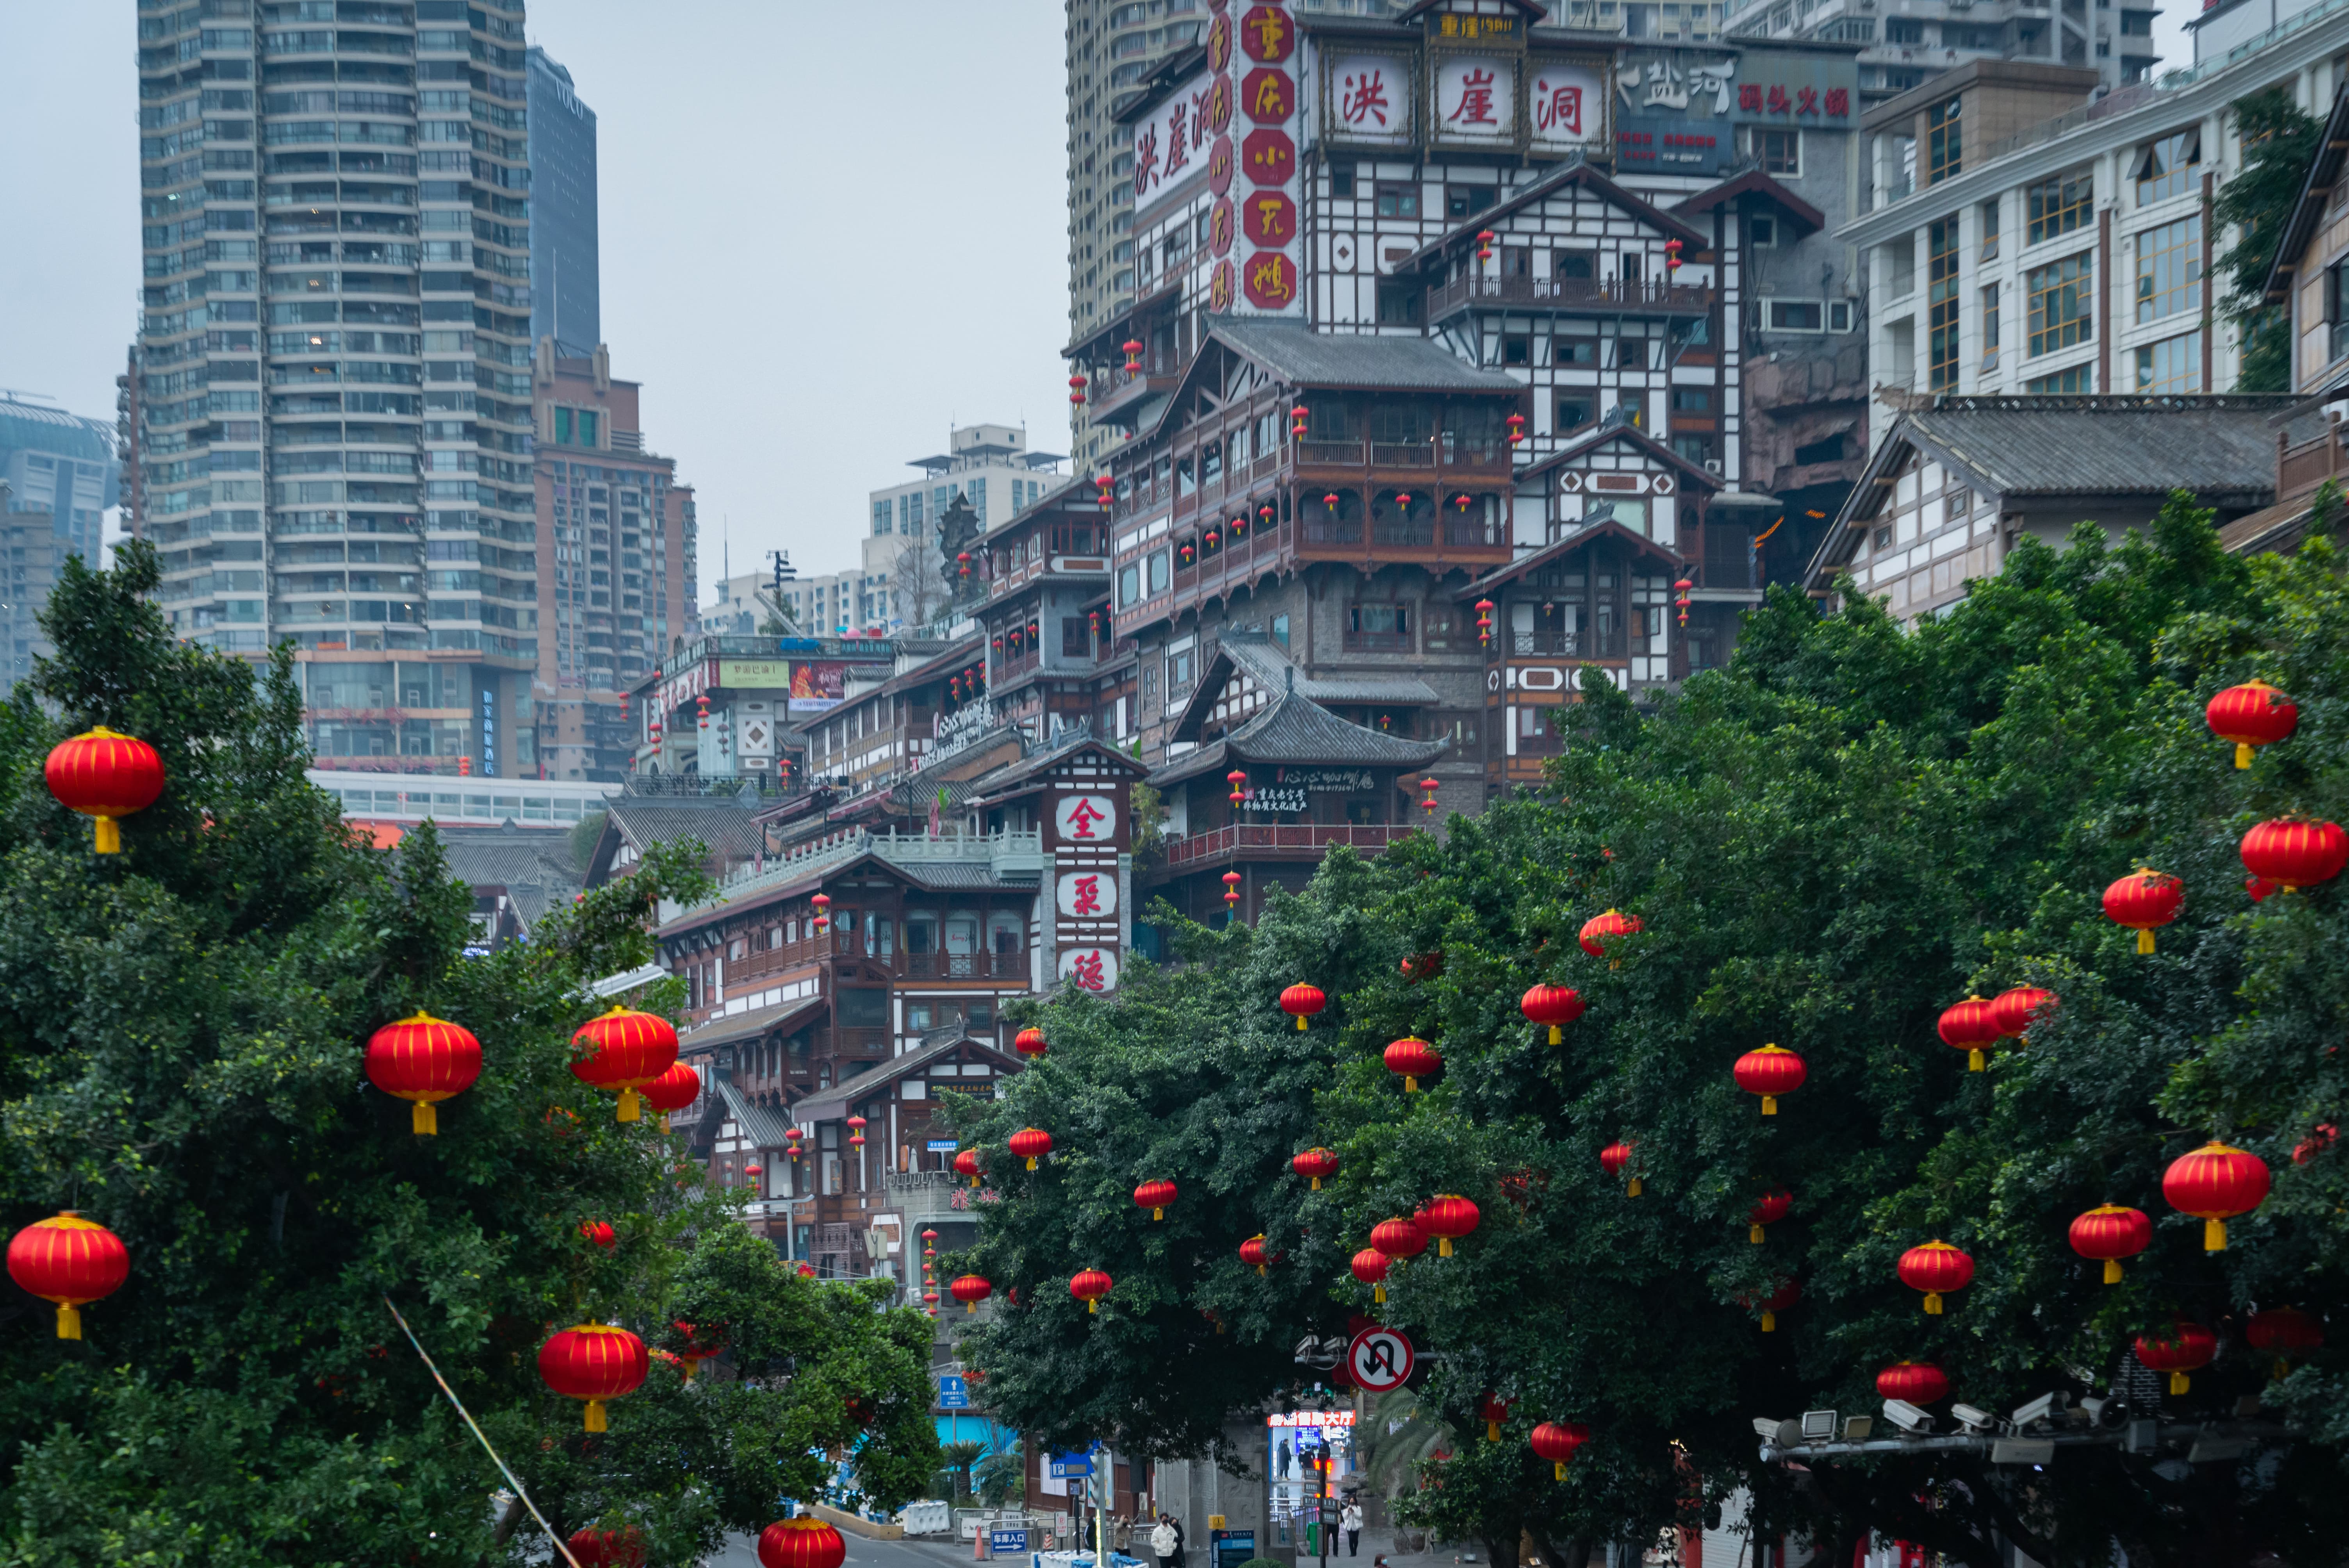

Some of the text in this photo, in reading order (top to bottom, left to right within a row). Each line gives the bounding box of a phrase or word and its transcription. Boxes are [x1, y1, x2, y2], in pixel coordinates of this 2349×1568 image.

[1344, 68, 1582, 135] 洪崖洞
[1738, 83, 1849, 116] 码头火锅
[1243, 800, 1307, 812] 非物质文化遗产
[1067, 798, 1106, 990] 全聚德
[1055, 1465, 1062, 1474] P
[994, 1534, 1024, 1543] 车库入口
